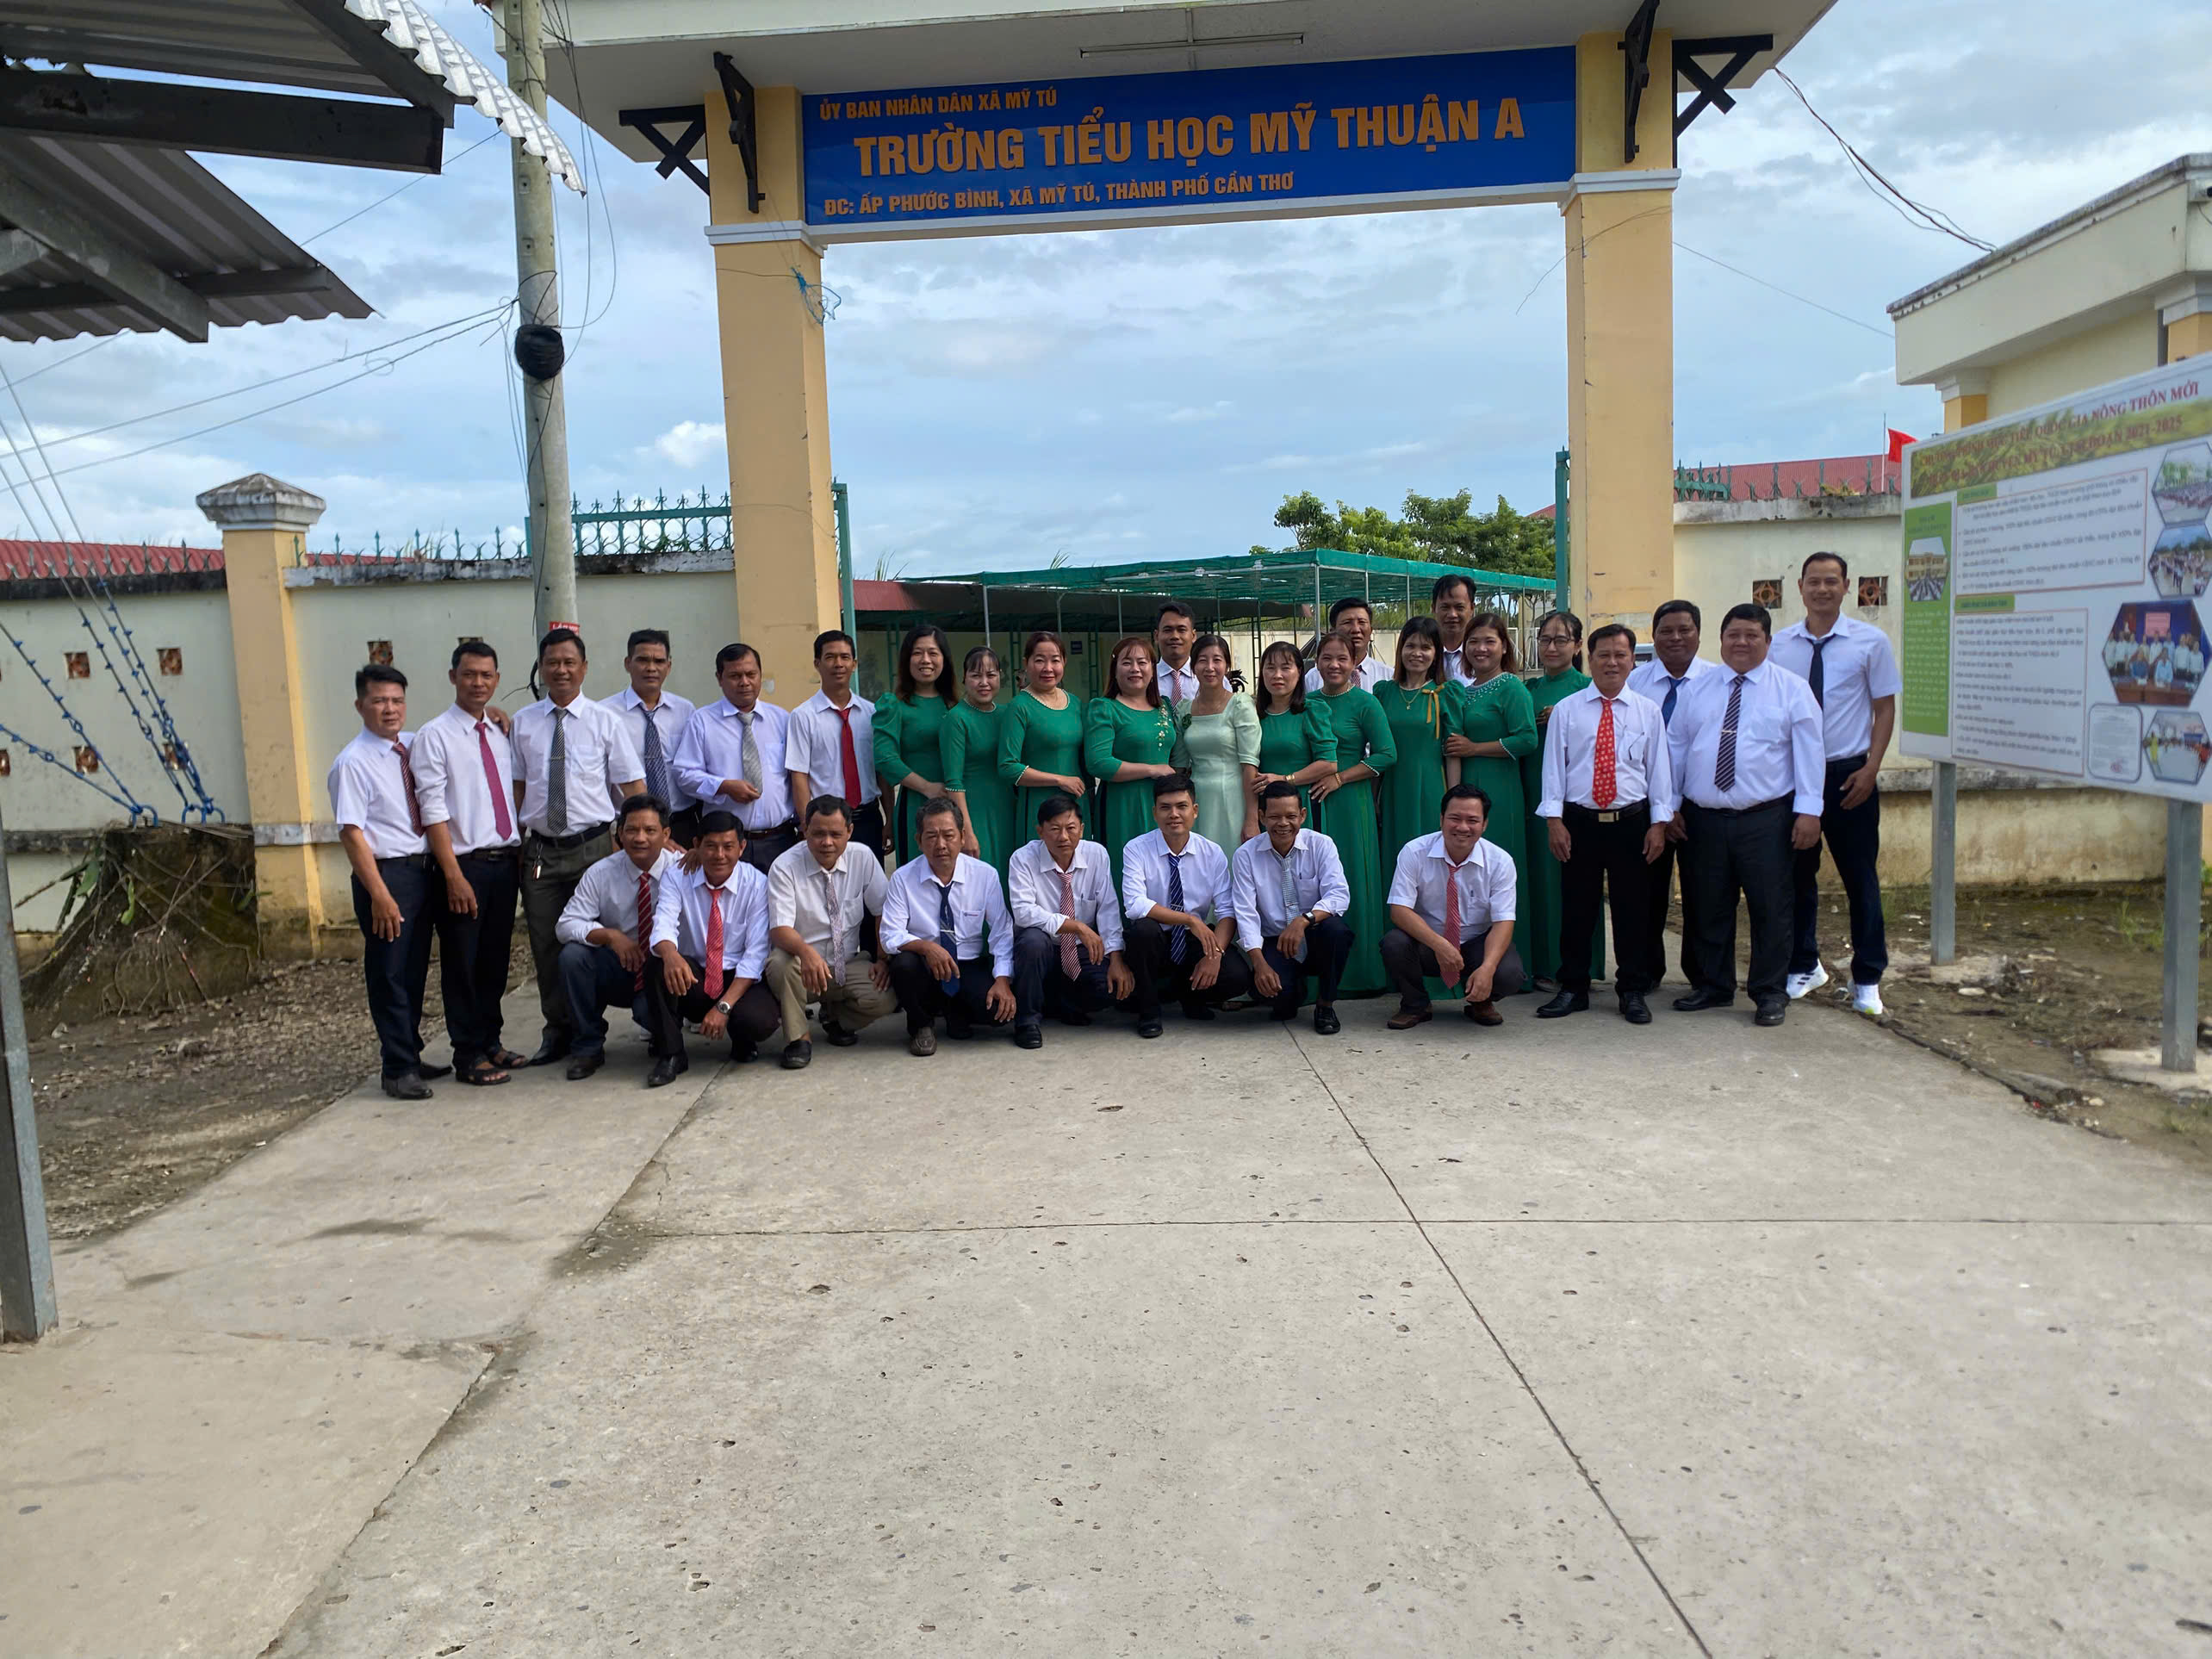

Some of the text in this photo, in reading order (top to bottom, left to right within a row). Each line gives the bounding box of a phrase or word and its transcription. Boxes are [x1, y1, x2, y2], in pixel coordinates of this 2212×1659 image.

[820, 86, 1057, 121] ỦY BAN NHÂN DÂN XÃ MỸ TÚ
[854, 94, 1525, 177] TRƯỜNG TIỂU HỌC MỸ THUẬN A
[824, 171, 1294, 215] ĐC: ẤP PHƯỚC BÌNH, XÃ MỸ TÚ, THÀNH PHỐ CẦN THƠ
[2091, 402, 2126, 421] NÔNG
[2129, 389, 2166, 412] THÔN
[2171, 379, 2199, 401] MỚI
